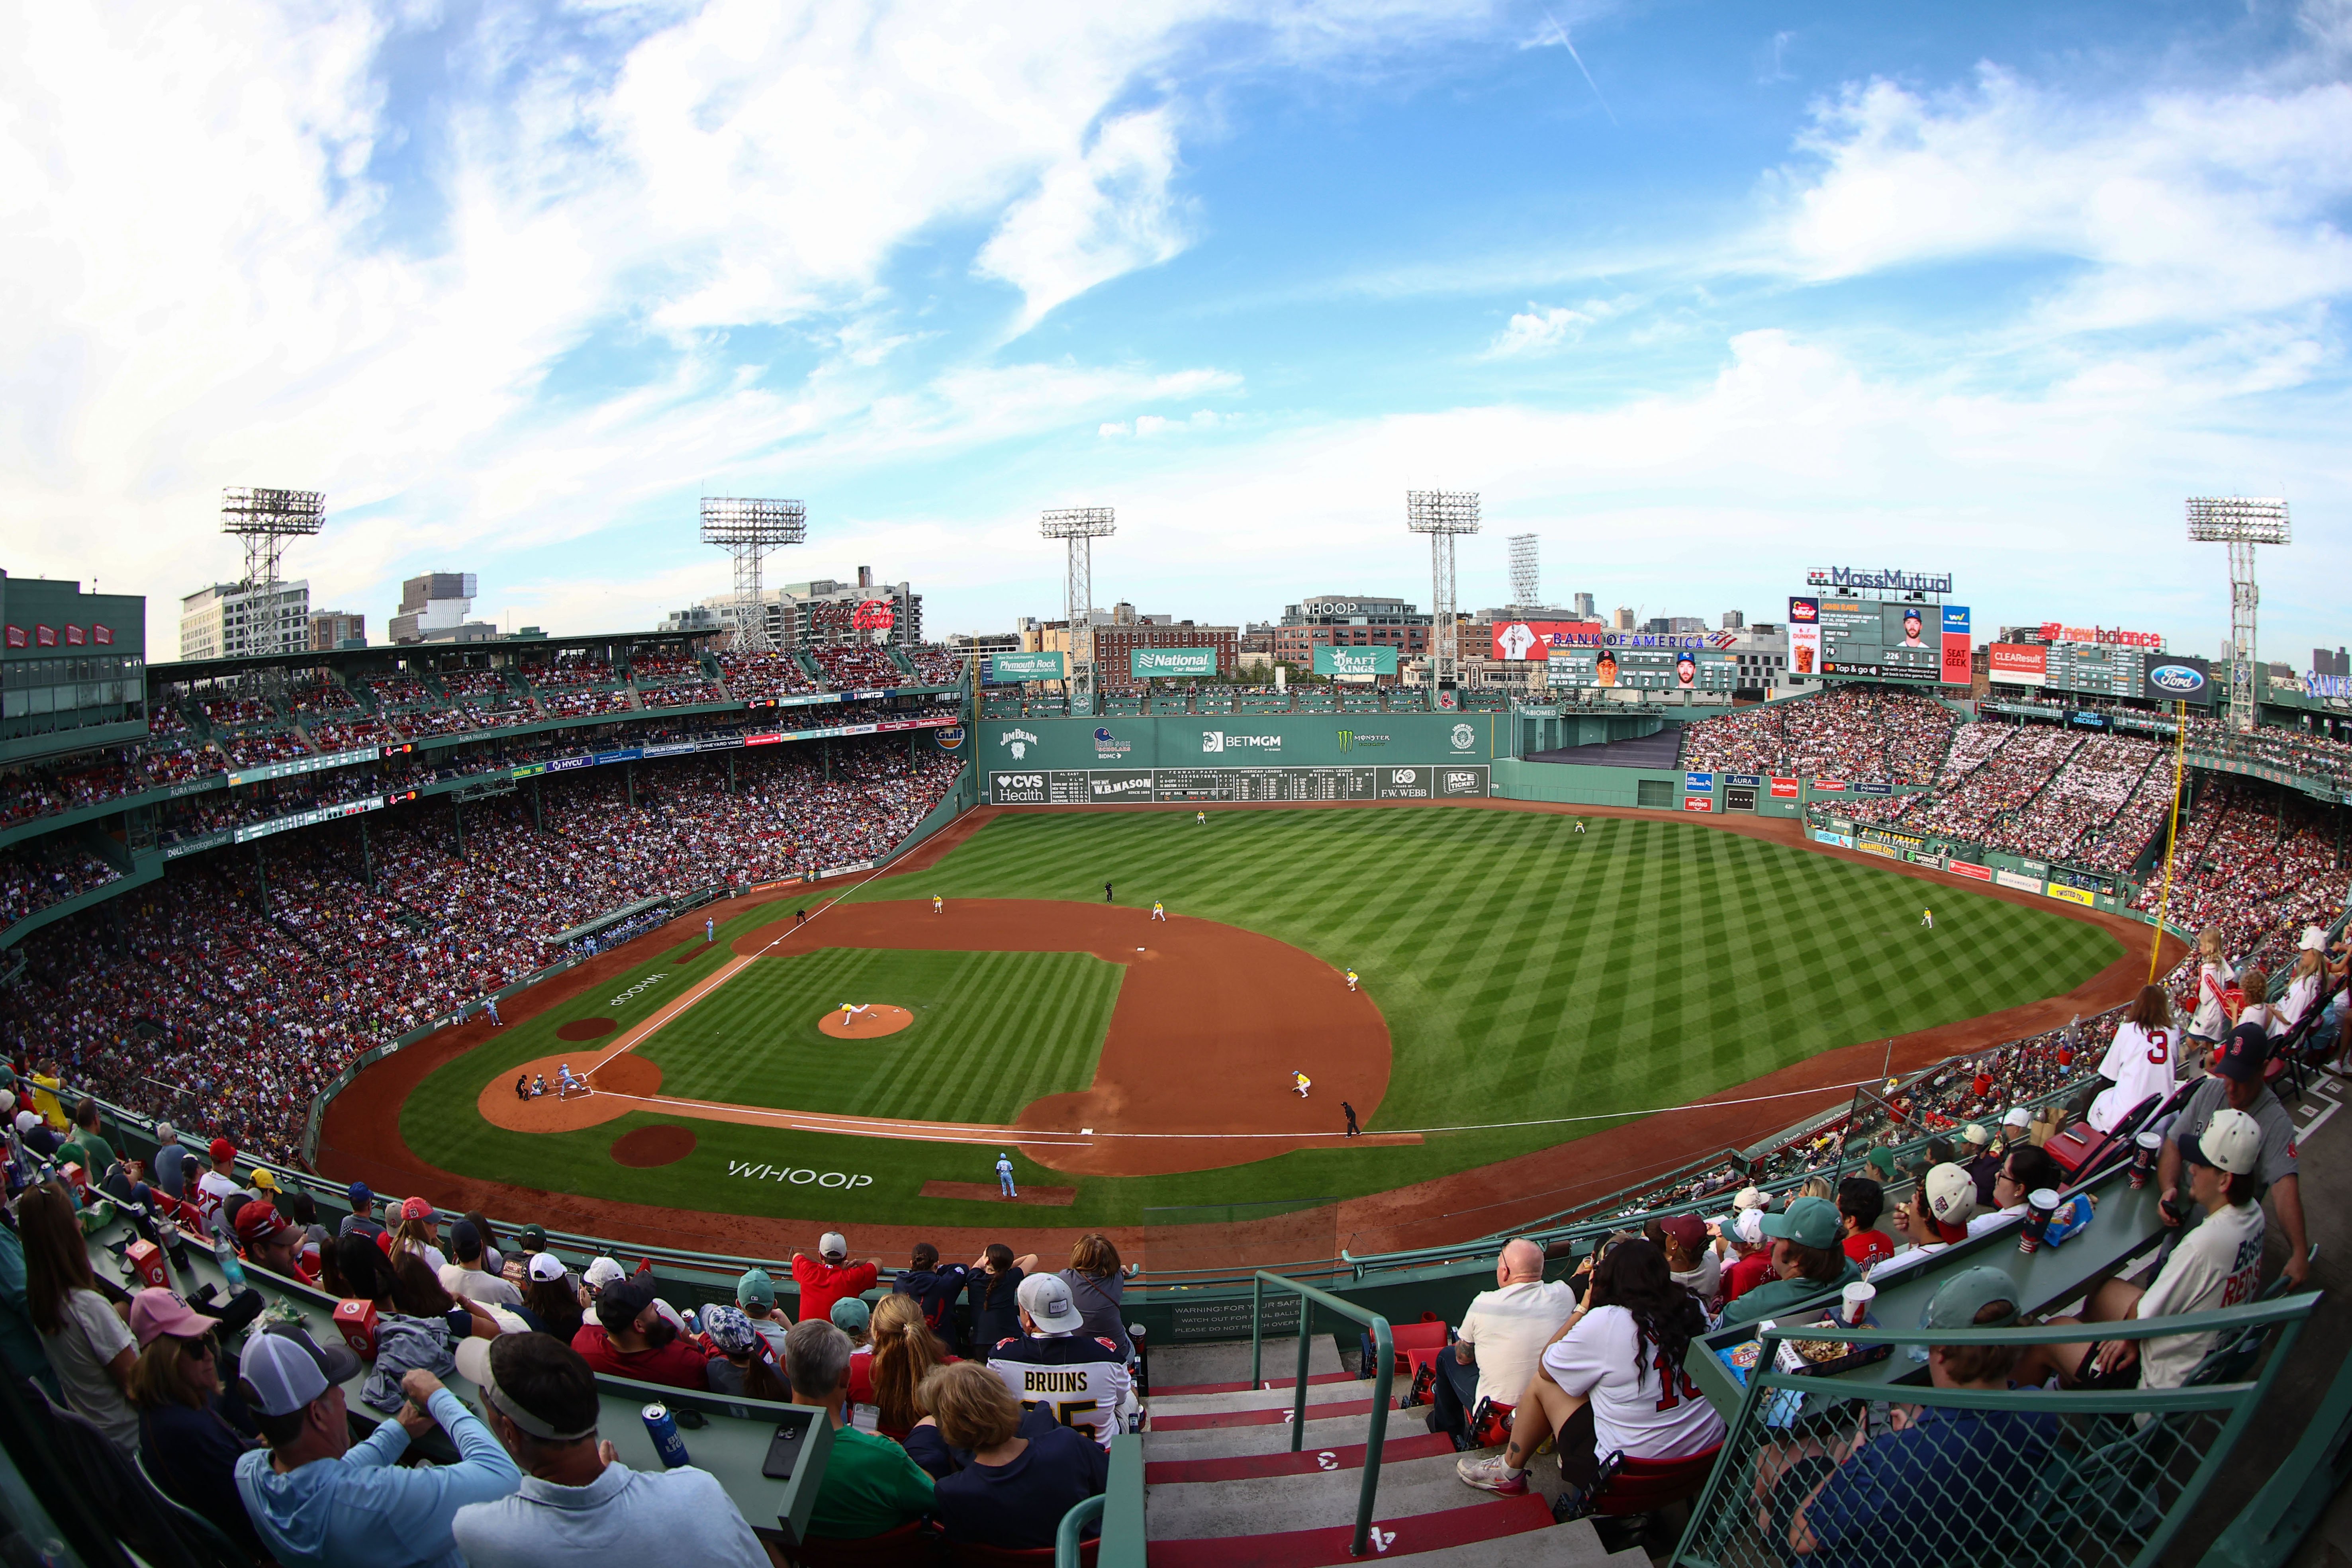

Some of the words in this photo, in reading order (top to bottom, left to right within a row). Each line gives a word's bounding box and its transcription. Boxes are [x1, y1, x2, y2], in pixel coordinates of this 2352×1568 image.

[1833, 566, 1952, 593] MassMutual
[811, 601, 854, 630] Coca
[853, 600, 897, 629] Cola
[1301, 603, 1356, 615] WHOOP
[1554, 633, 1600, 645] BANK
[1607, 634, 1627, 646] OF
[1632, 635, 1704, 649] AMERICA
[2064, 627, 2096, 642] new
[2096, 625, 2160, 647] balance
[1947, 649, 1966, 658] SEAT
[1994, 652, 2042, 664] CLEAResult
[1000, 660, 1035, 670] Plymouth
[1036, 659, 1056, 668] Rock
[1155, 653, 1208, 667] National
[1333, 657, 1377, 666] DRAFT
[1945, 658, 1967, 667] GEEK
[1339, 664, 1375, 673] KINGS
[1835, 664, 1849, 673] Tap
[2163, 669, 2194, 688] Ford
[2073, 717, 2103, 726] ORCHARD
[936, 729, 963, 739] Gulf
[1000, 731, 1014, 746] JIM
[1014, 728, 1038, 746] BEAM
[1226, 735, 1281, 746] BETMGM
[562, 760, 582, 768] HYCU
[513, 767, 531, 777] SULLIVAN
[1450, 773, 1475, 783] ACE
[188, 781, 212, 793] PAVILION
[1012, 775, 1043, 788] CVS
[1451, 781, 1475, 789] TICKET
[999, 789, 1044, 801] Health
[1818, 832, 1836, 842] jetBlue
[183, 838, 213, 853] Technologies
[214, 834, 227, 845] Level
[1859, 842, 1883, 852] GRANITE
[1883, 846, 1895, 857] CITY
[1916, 854, 1939, 864] wasabi
[2056, 889, 2076, 899] TWISTED
[611, 972, 668, 1006] WHOOP
[435, 1018, 449, 1029] Franklin
[2147, 1030, 2168, 1065] 3
[2231, 1036, 2244, 1056] B
[728, 1160, 873, 1190] WHOOP
[198, 1188, 223, 1221] 27
[1025, 1371, 1087, 1392] BRUINS
[665, 1439, 682, 1453] LIG
[1317, 1451, 1339, 1471] 3
[1371, 1527, 1396, 1552] 4
